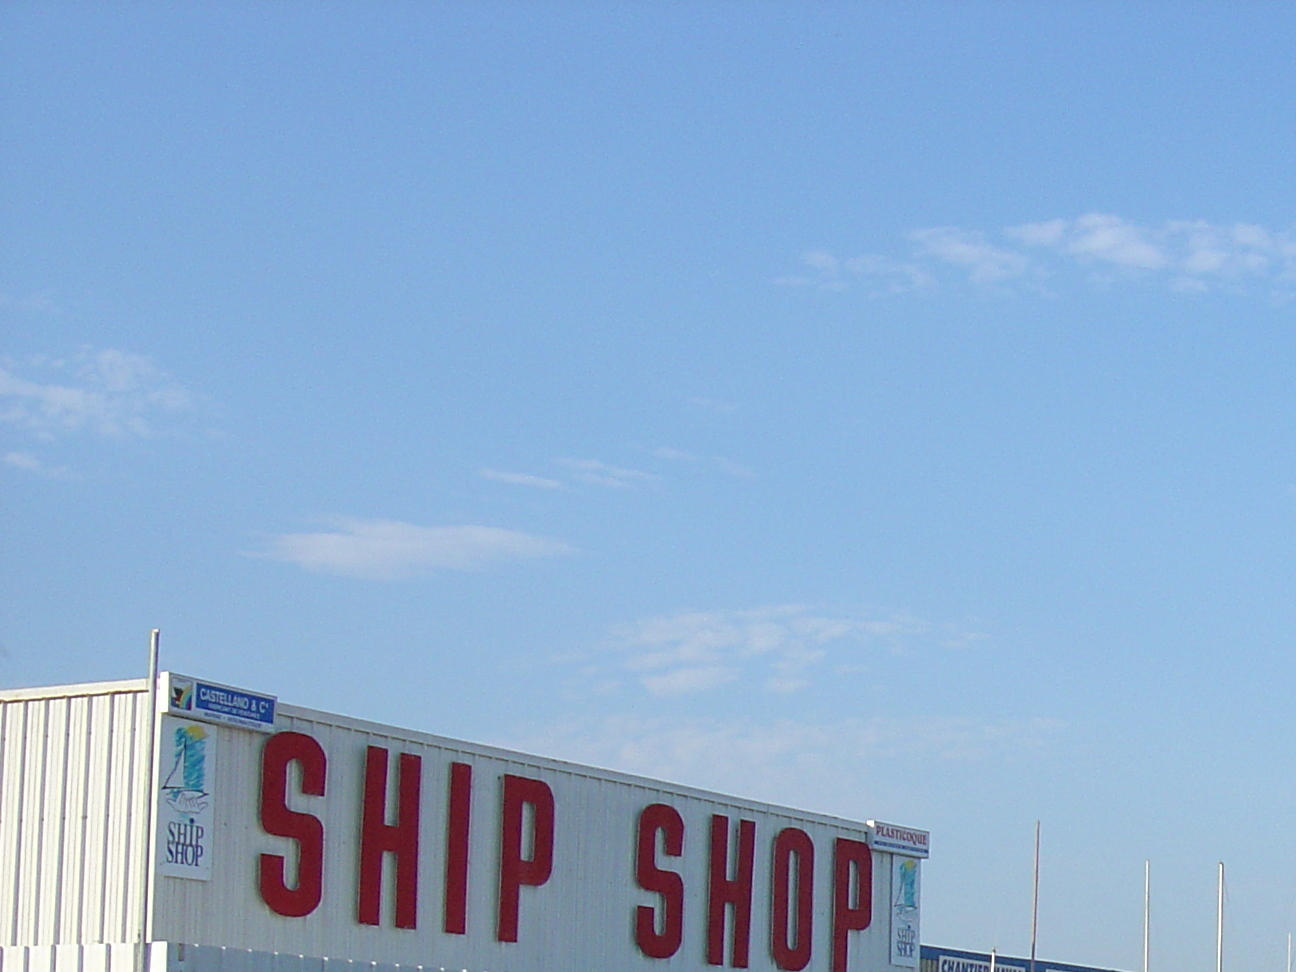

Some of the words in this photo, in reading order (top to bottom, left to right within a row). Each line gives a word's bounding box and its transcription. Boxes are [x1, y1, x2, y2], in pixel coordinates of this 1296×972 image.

[200, 688, 249, 709] CASTELLANO
[251, 699, 257, 711] &
[167, 818, 205, 846] SHIP
[259, 730, 555, 943] SHIP
[876, 825, 927, 846] PLASTICOQUE
[166, 836, 204, 867] SHOP
